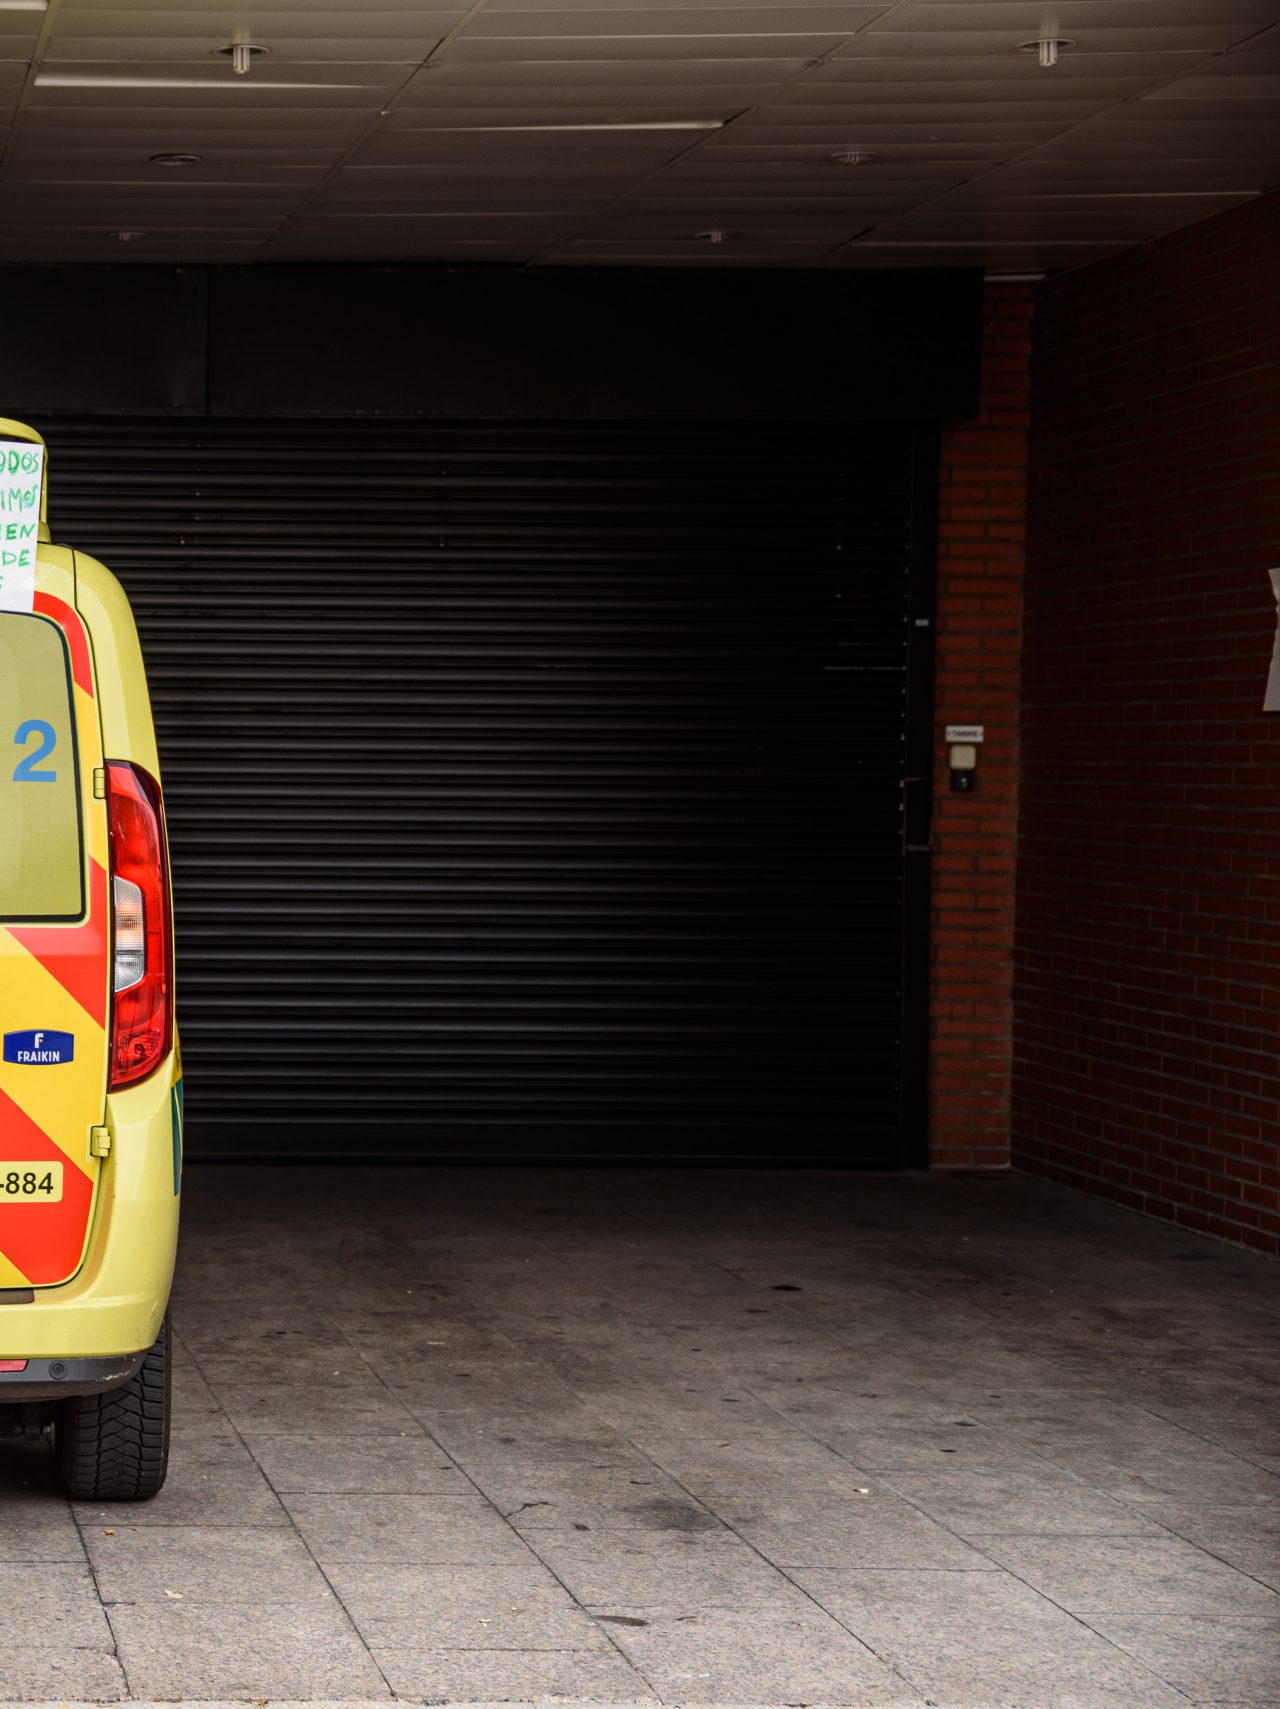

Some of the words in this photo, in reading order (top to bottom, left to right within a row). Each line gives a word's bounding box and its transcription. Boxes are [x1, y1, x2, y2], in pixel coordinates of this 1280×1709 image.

[2, 549, 31, 566] DE
[34, 1032, 44, 1049] F
[17, 1050, 60, 1062] FRAIKIN
